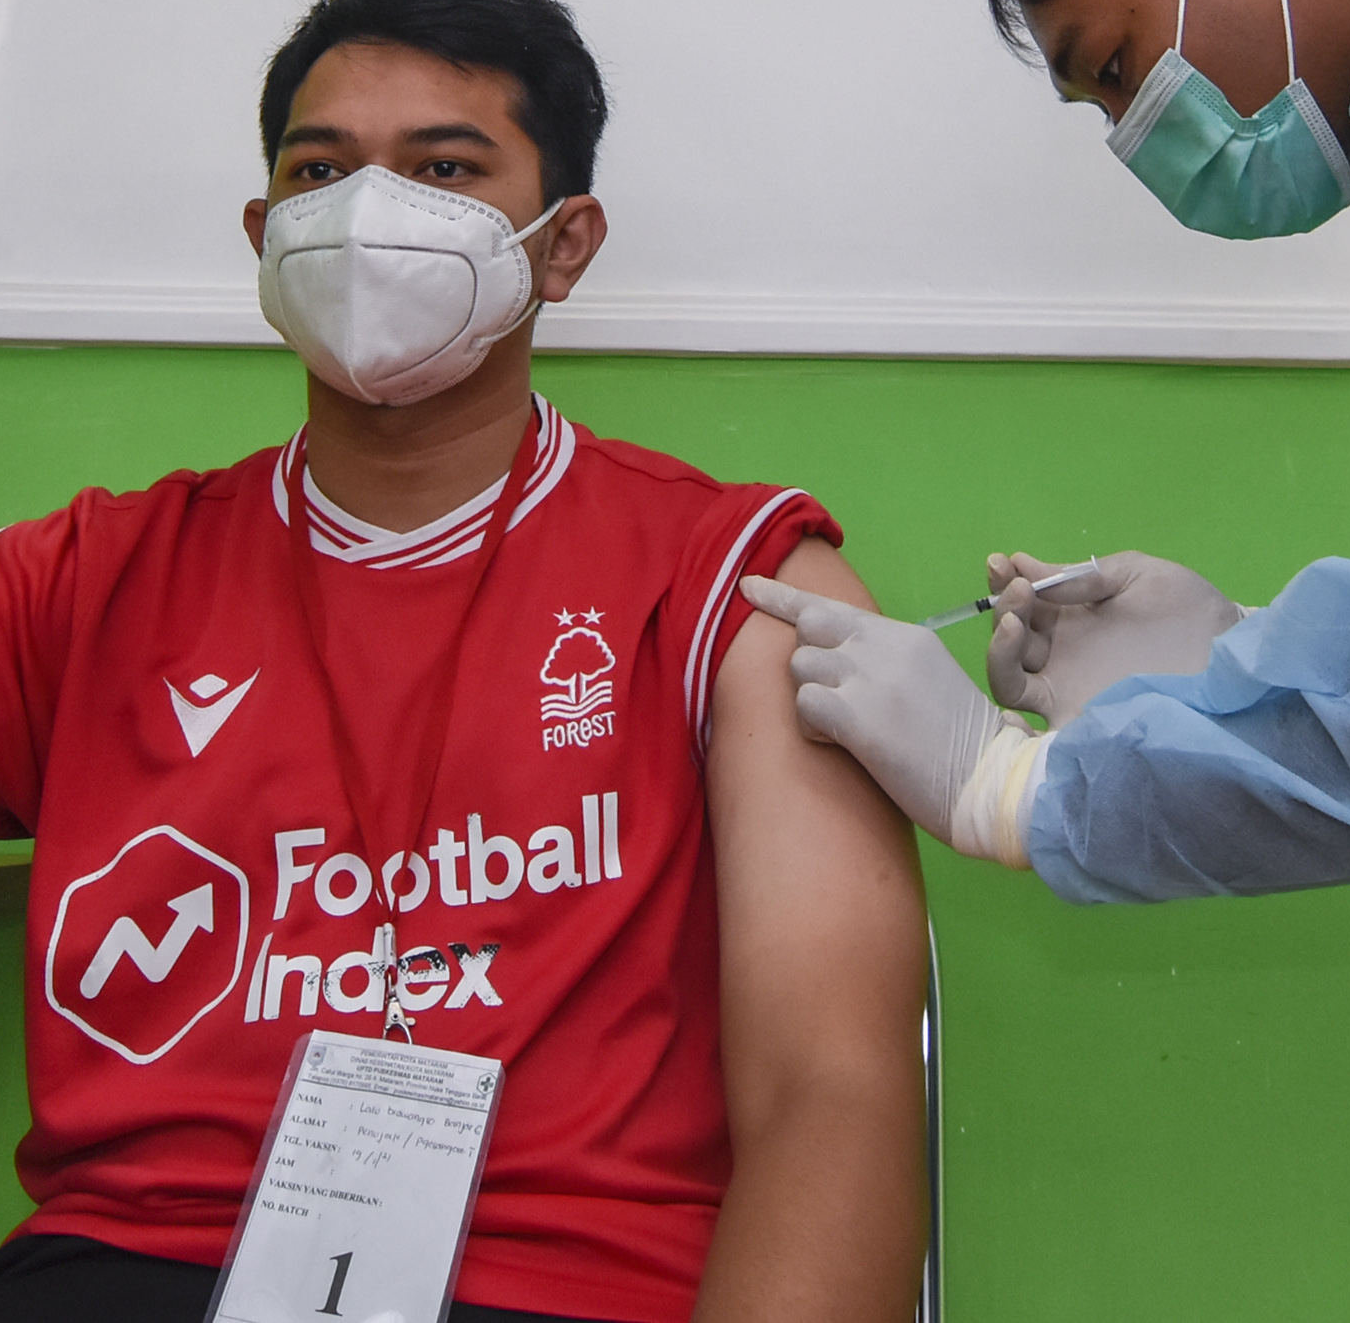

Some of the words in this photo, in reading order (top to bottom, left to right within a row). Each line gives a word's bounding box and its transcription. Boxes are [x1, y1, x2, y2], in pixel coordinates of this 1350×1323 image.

[272, 791, 622, 921] Football
[244, 926, 504, 1023] Index
[417, 1059, 448, 1069] MATARAM
[372, 1068, 411, 1079] PUSKESMAS
[411, 1073, 444, 1084] MATARAM
[296, 1093, 323, 1105] NAMA
[360, 1102, 380, 1115] Lalu
[289, 1115, 327, 1128] ALAMAT
[283, 1135, 302, 1146] TGL.
[275, 1156, 295, 1167] JAM
[269, 1179, 303, 1192] VAKSIN
[304, 1185, 328, 1198] YANG
[260, 1200, 276, 1210] NO.
[278, 1203, 309, 1217] BATCH
[315, 1251, 353, 1317] 1
